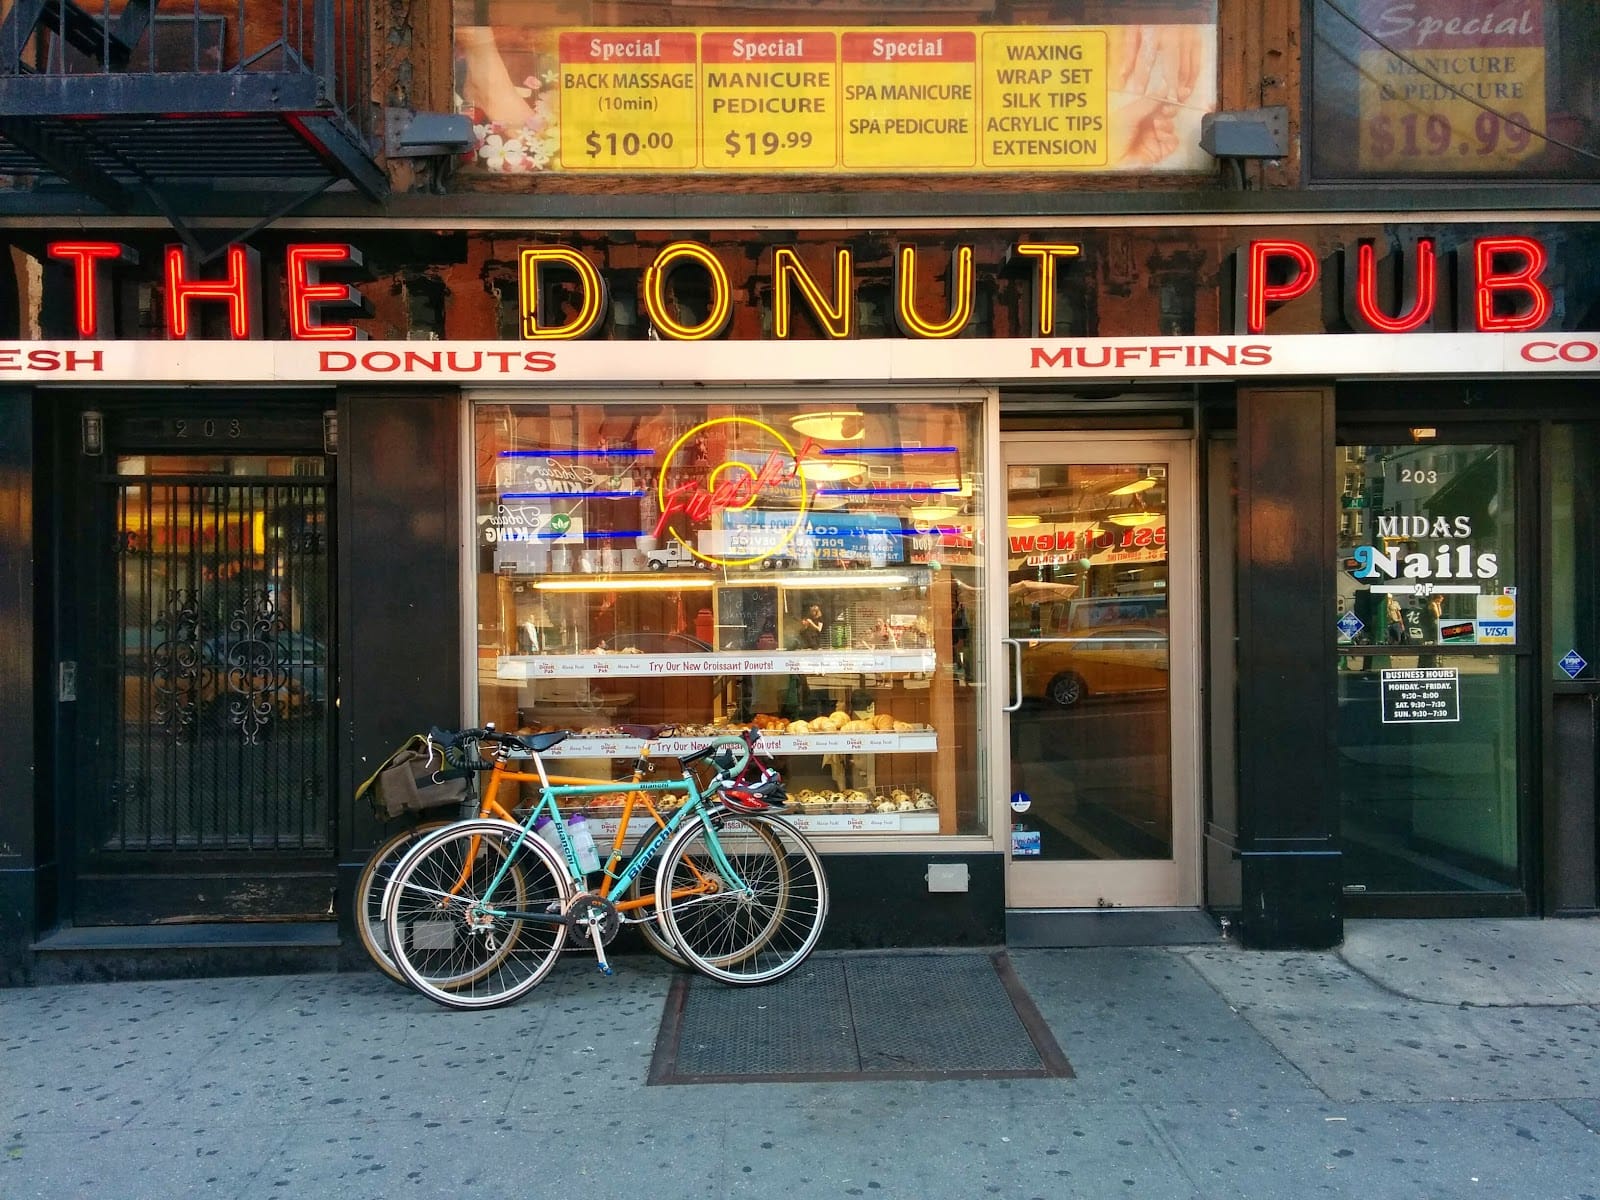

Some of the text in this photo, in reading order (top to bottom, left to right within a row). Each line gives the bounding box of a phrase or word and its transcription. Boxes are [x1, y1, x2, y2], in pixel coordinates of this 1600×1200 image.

[1374, 2, 1533, 46] Special
[590, 38, 661, 60] Special
[732, 38, 804, 60] Special
[872, 38, 943, 60] Special
[1006, 45, 1083, 61] WAXING
[1386, 56, 1516, 76] MANICURE
[564, 73, 694, 90] BACK MASSAGE
[707, 72, 831, 89] MANICURE
[996, 69, 1093, 85] WRAP SET
[845, 85, 973, 101] SPA MANICURE
[1379, 82, 1524, 101] & PEDICURE
[598, 96, 659, 112] (10min)
[713, 98, 826, 114] PEDICURE
[1002, 92, 1087, 109] SILK TIPS
[849, 118, 969, 135] SPA PEDICURE
[986, 116, 1103, 132] ACRYLIC TIPS
[1369, 111, 1533, 159] $19.99
[585, 130, 674, 158] $10.00
[725, 130, 813, 158] $19.99
[992, 140, 1097, 156] EXTENSION
[48, 237, 1555, 340] THE DONUT PUB
[318, 351, 557, 373] DONUTS
[1030, 345, 1273, 368] MUFFINS
[1520, 341, 1599, 363] CO
[175, 420, 243, 438] 203
[1401, 469, 1438, 484] 203
[1376, 515, 1472, 538] MIDAS
[1354, 543, 1498, 579] Nails
[1414, 582, 1433, 597] 2F
[1484, 627, 1508, 637] VISA
[649, 661, 663, 672] Try
[666, 661, 680, 671] Our
[683, 661, 701, 671] New
[703, 660, 741, 671] Croissant
[744, 660, 774, 670] Donuts!
[1385, 670, 1454, 679] BUSINESS HOURS
[657, 742, 671, 752] Try
[674, 742, 688, 751] Our
[555, 822, 574, 865] Bianchi
[628, 826, 673, 882] Bianchi
